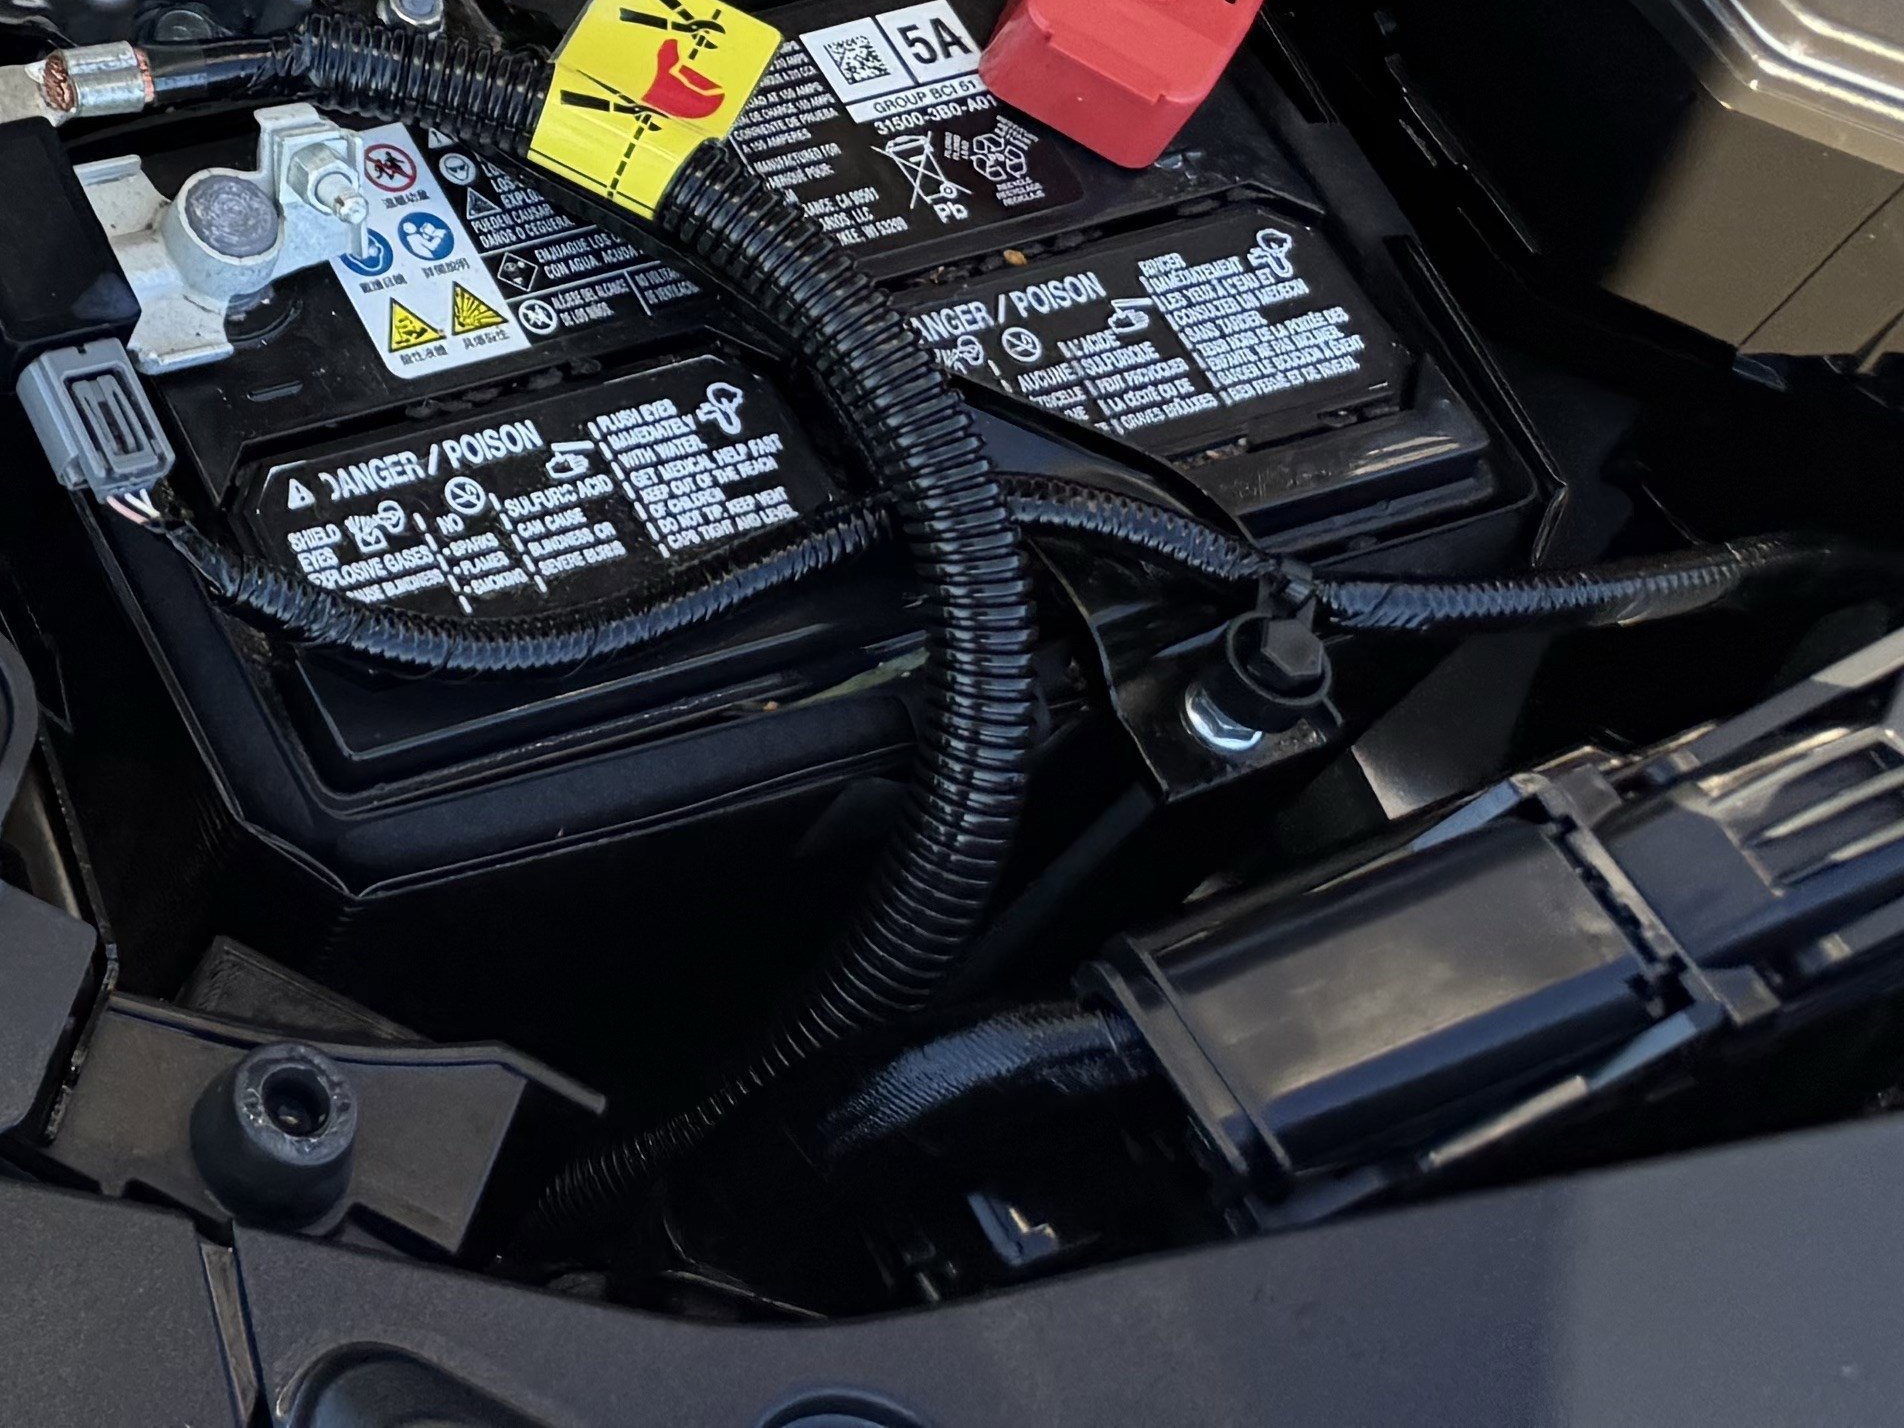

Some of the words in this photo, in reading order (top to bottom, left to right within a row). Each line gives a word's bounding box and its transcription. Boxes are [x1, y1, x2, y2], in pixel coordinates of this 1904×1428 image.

[896, 17, 973, 65] 5A
[872, 90, 927, 115] GROUP
[930, 81, 958, 99] BCI
[471, 212, 513, 235] PUEDEN
[932, 197, 969, 224] Pb
[543, 260, 569, 279] CON
[568, 252, 602, 273] AGUA.
[1008, 270, 1107, 319] POISON
[1159, 290, 1186, 311] LES
[1174, 298, 1237, 327] CONSULTER
[1184, 320, 1217, 342] SANS
[1016, 362, 1077, 392] AUCUNE
[1080, 340, 1160, 377] SULFURIQUE
[638, 397, 677, 421] EYES
[441, 418, 544, 469] POISON
[616, 445, 656, 469] WITH
[628, 466, 659, 488] GET
[656, 451, 716, 481] MEDICAL
[711, 442, 749, 466] HELP
[746, 432, 784, 456] FAST
[576, 473, 614, 498] ACID
[638, 483, 670, 503] KEEP
[670, 476, 697, 495] OUT
[694, 471, 714, 488] OF
[711, 464, 740, 484] THE
[736, 455, 779, 477] REACH
[435, 511, 466, 537] NO
[516, 518, 546, 538] CAN
[543, 506, 587, 531] CAUSE
[648, 501, 668, 518] OF
[656, 515, 679, 534] DO
[675, 508, 704, 528] NOT
[725, 494, 757, 514] KEEP
[753, 485, 788, 507] VENT
[286, 522, 343, 552] SHIELD
[526, 526, 595, 557] BLINDNESS
[665, 528, 701, 550] CAPS
[697, 519, 735, 541] TIGHT
[733, 512, 761, 531] AND
[296, 545, 339, 572] EYES
[382, 544, 434, 574] GASES
[537, 550, 586, 576] SEVERE
[381, 567, 445, 597] BLINDNESS
[469, 567, 529, 595] SMOKING
